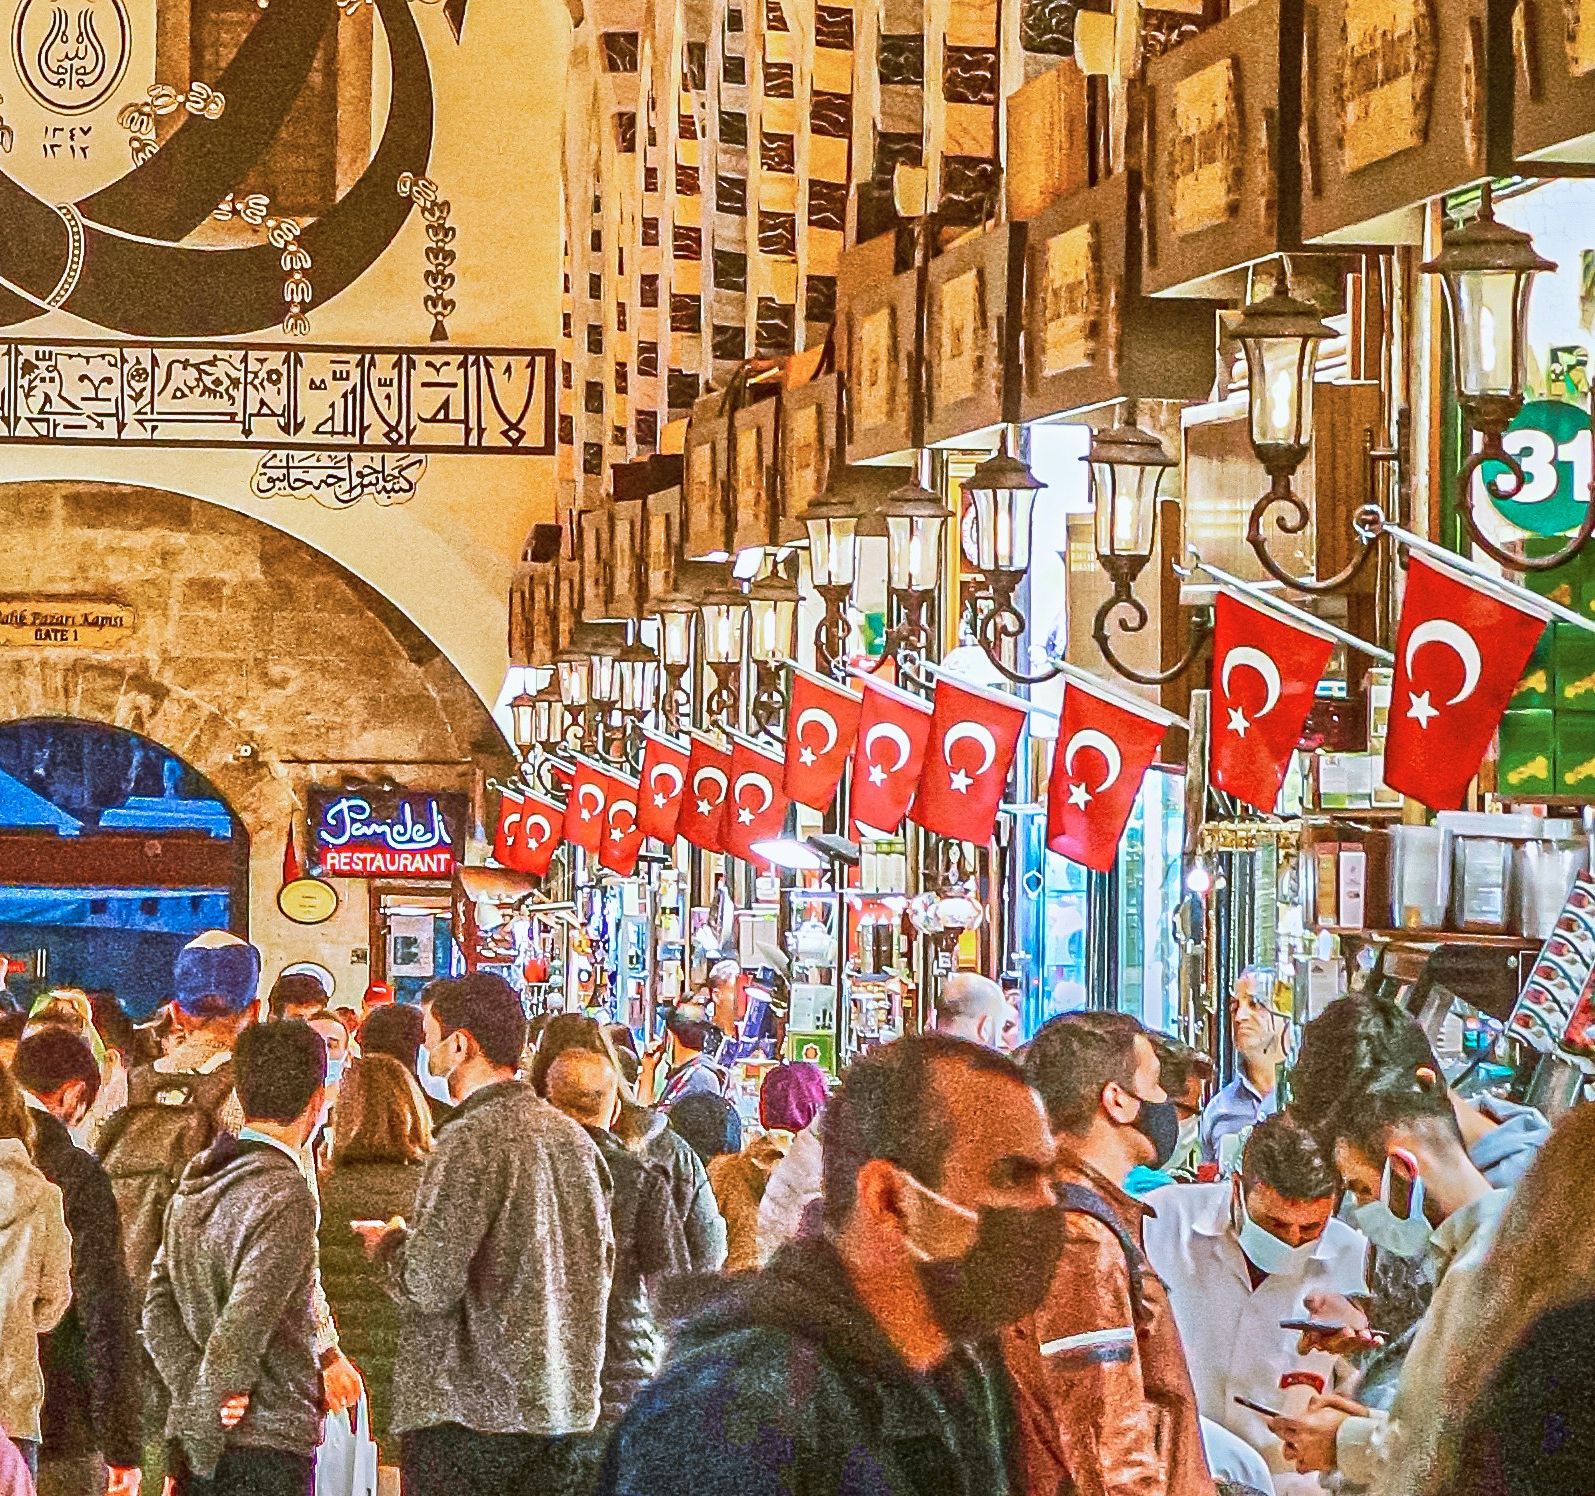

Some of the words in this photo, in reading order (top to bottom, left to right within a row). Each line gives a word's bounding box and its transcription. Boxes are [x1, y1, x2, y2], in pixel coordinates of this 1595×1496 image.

[34, 628, 69, 642] GATE
[72, 629, 79, 641] 1
[326, 852, 451, 872] RESTAURANT
